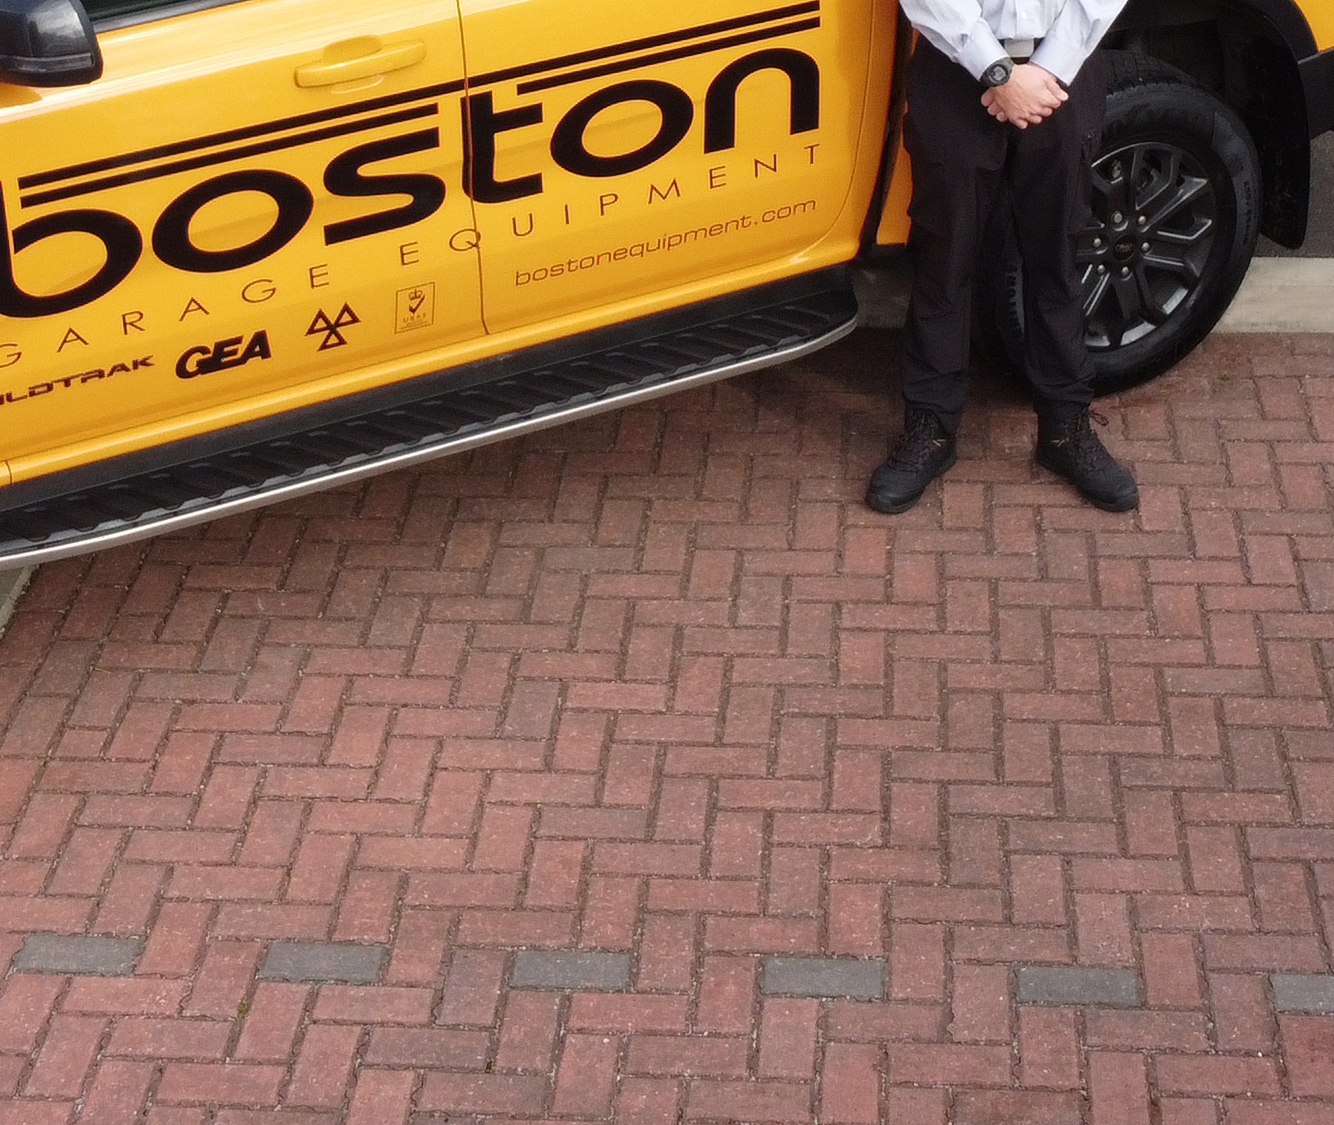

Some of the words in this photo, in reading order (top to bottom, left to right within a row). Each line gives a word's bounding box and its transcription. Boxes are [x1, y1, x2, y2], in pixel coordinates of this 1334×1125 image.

[400, 144, 821, 266] EQUIPMENT
[515, 199, 816, 286] bostonequipment.com
[175, 330, 271, 379] GEA
